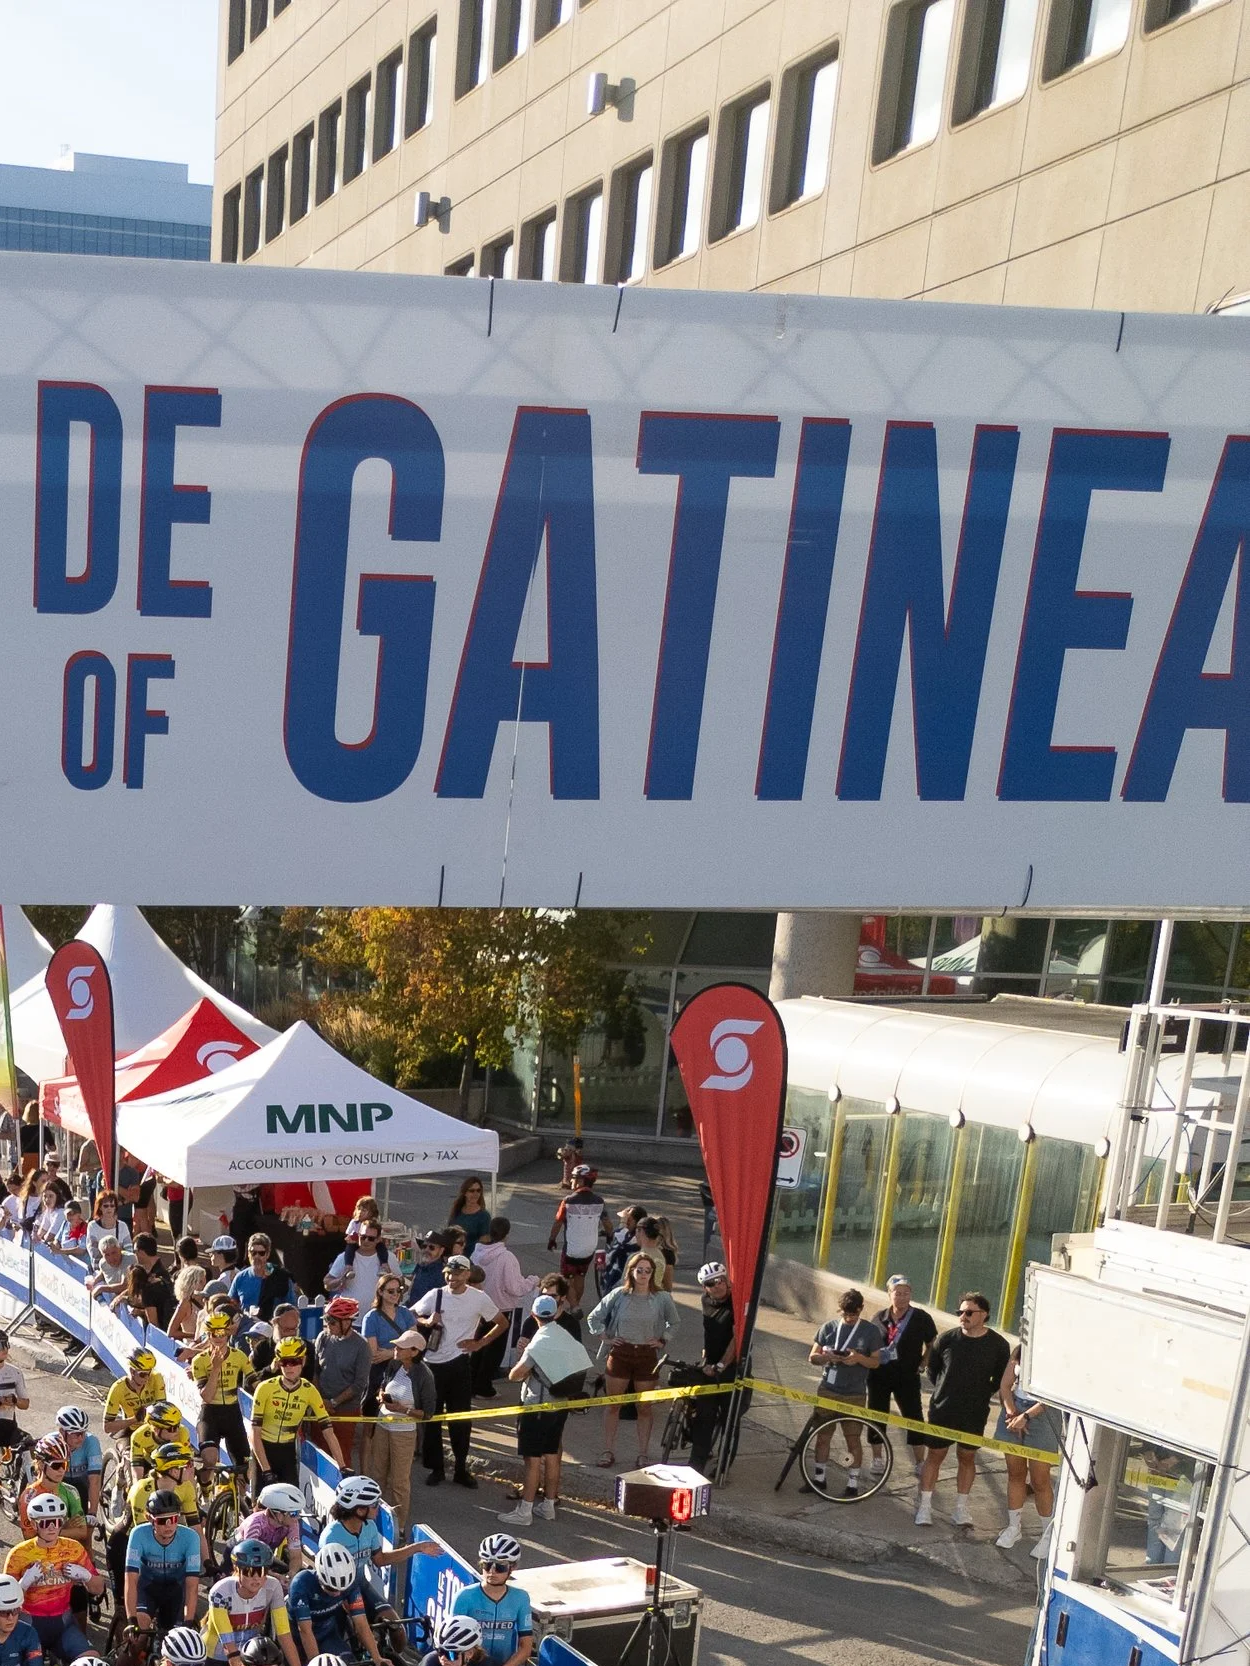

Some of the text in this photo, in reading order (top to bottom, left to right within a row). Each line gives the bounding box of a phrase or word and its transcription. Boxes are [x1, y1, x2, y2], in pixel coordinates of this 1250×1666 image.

[32, 380, 223, 618] DE
[61, 649, 177, 791] OF
[266, 1103, 393, 1134] MNP
[228, 1150, 459, 1171] ACCOUNTING CONSULTING TAX
[670, 1487, 692, 1521] 0
